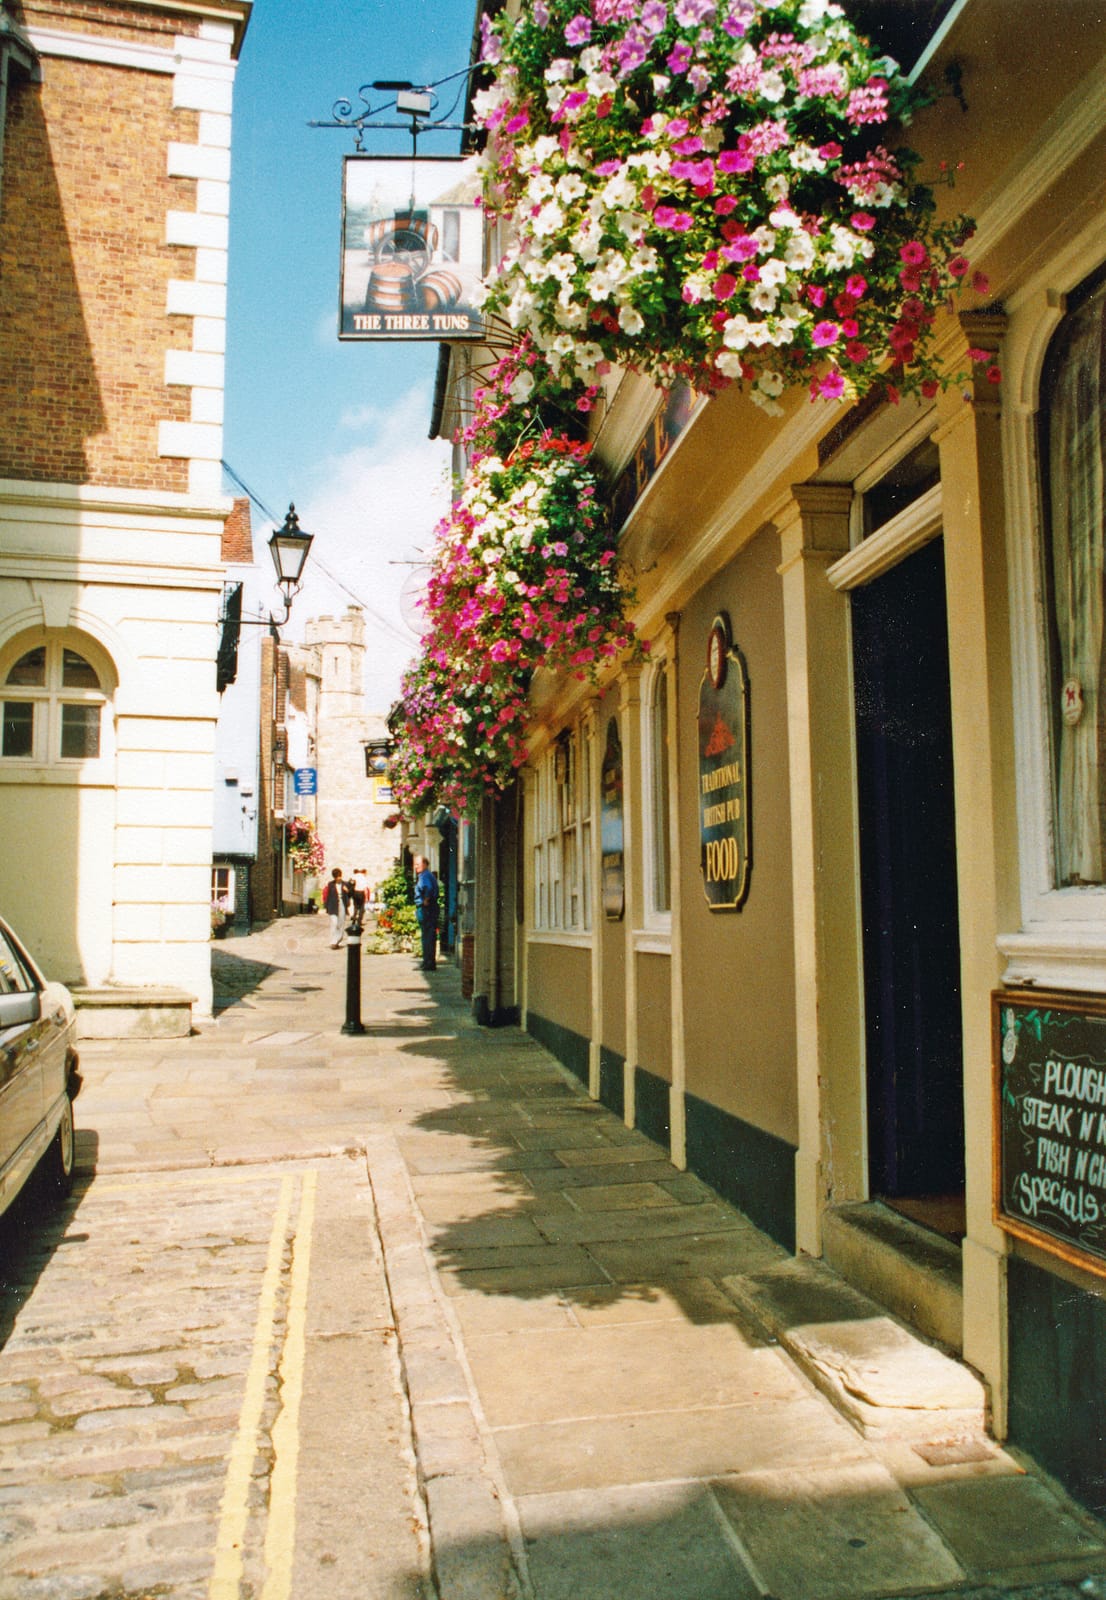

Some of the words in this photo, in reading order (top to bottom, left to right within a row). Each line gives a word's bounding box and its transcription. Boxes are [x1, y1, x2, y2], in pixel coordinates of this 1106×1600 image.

[353, 314, 382, 330] THE
[384, 314, 430, 330] THREE
[432, 314, 469, 330] TUNS
[702, 761, 740, 794] TRADITIONAL
[703, 802, 726, 828] BRITISH
[726, 798, 740, 821] PUB
[706, 837, 738, 882] FOOD
[1023, 1096, 1073, 1137] STEAK
[1037, 1136, 1070, 1177] FISH
[1020, 1171, 1099, 1224] Specials
